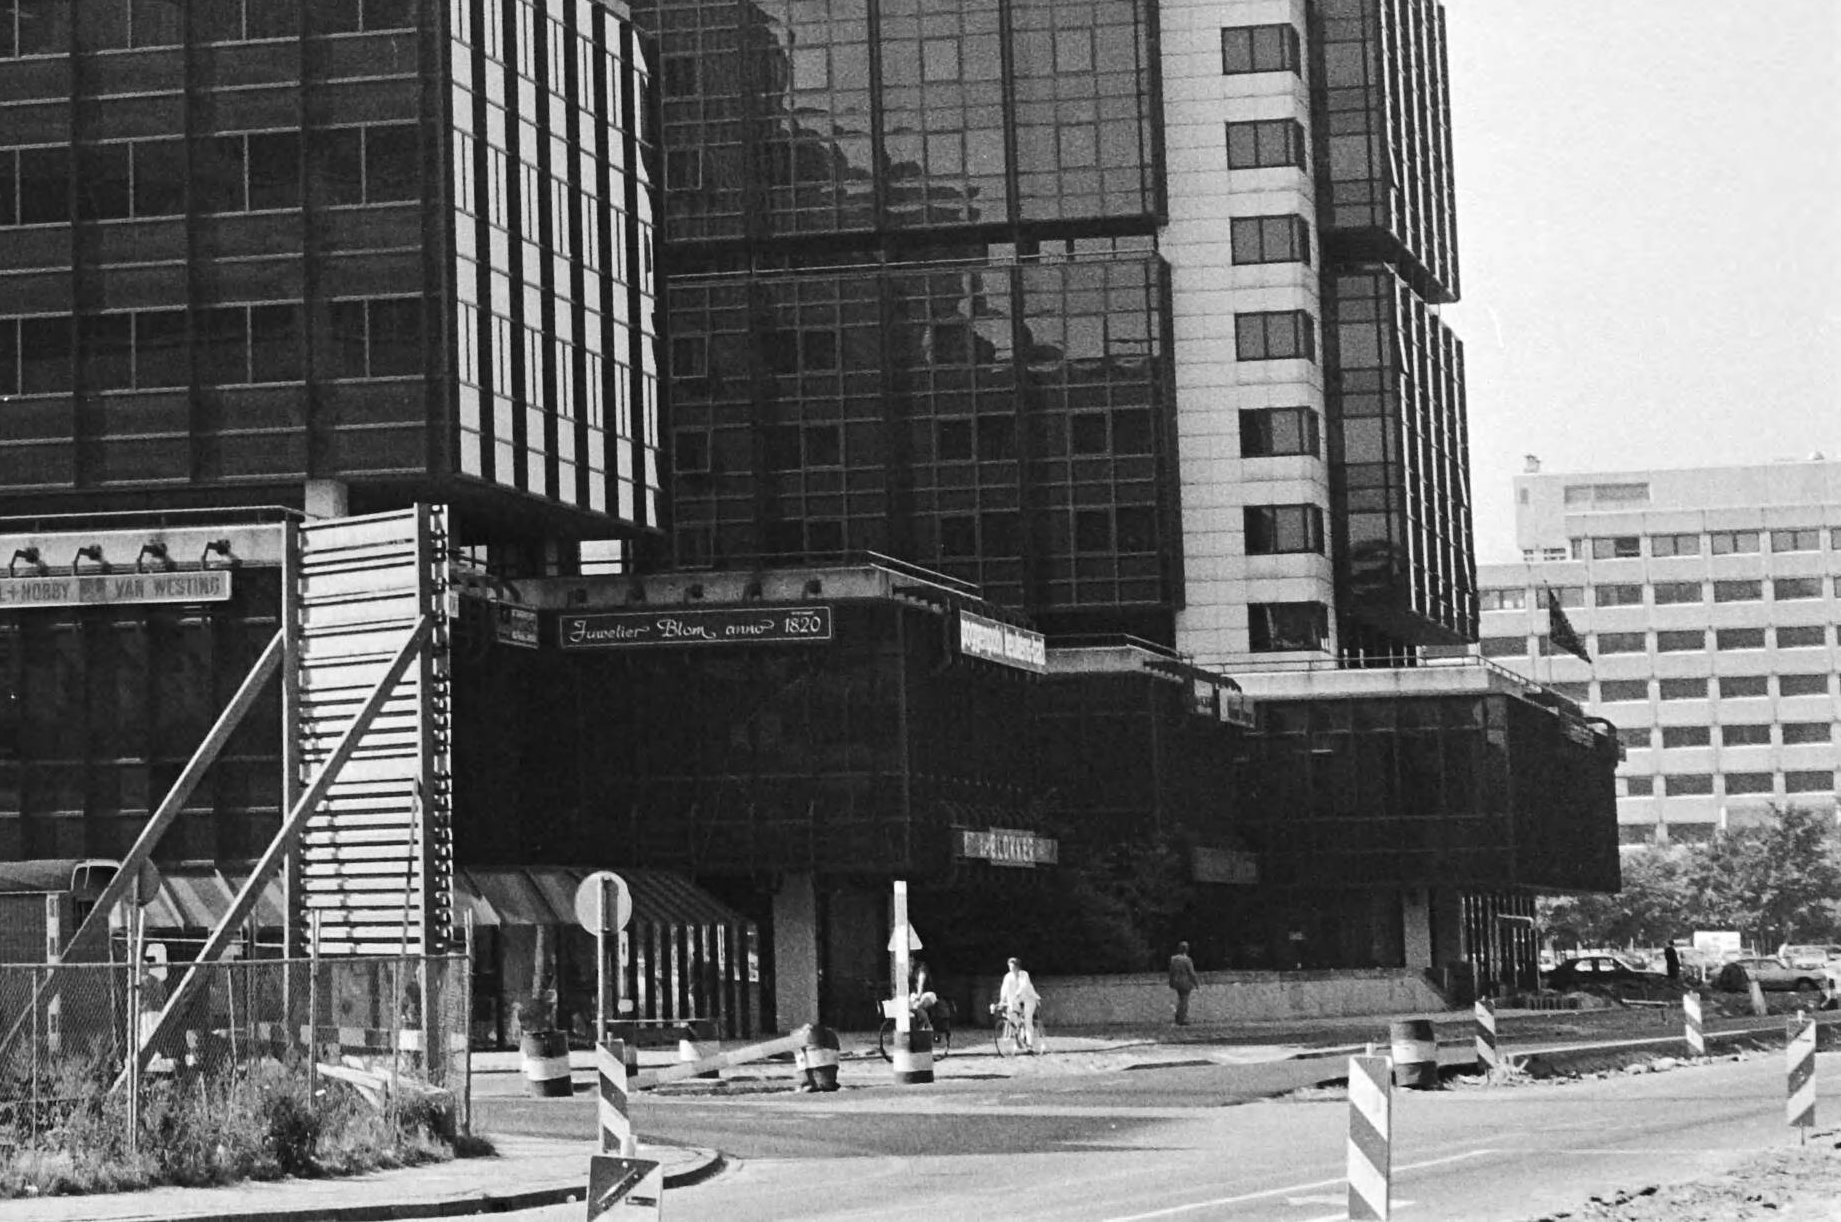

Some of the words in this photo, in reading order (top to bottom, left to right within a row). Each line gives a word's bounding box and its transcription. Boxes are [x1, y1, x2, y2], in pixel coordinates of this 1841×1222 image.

[115, 579, 144, 598] VAN
[568, 619, 650, 642] Juwelier
[657, 619, 716, 641] Blom
[725, 619, 774, 636] anno
[784, 616, 821, 634] 1820
